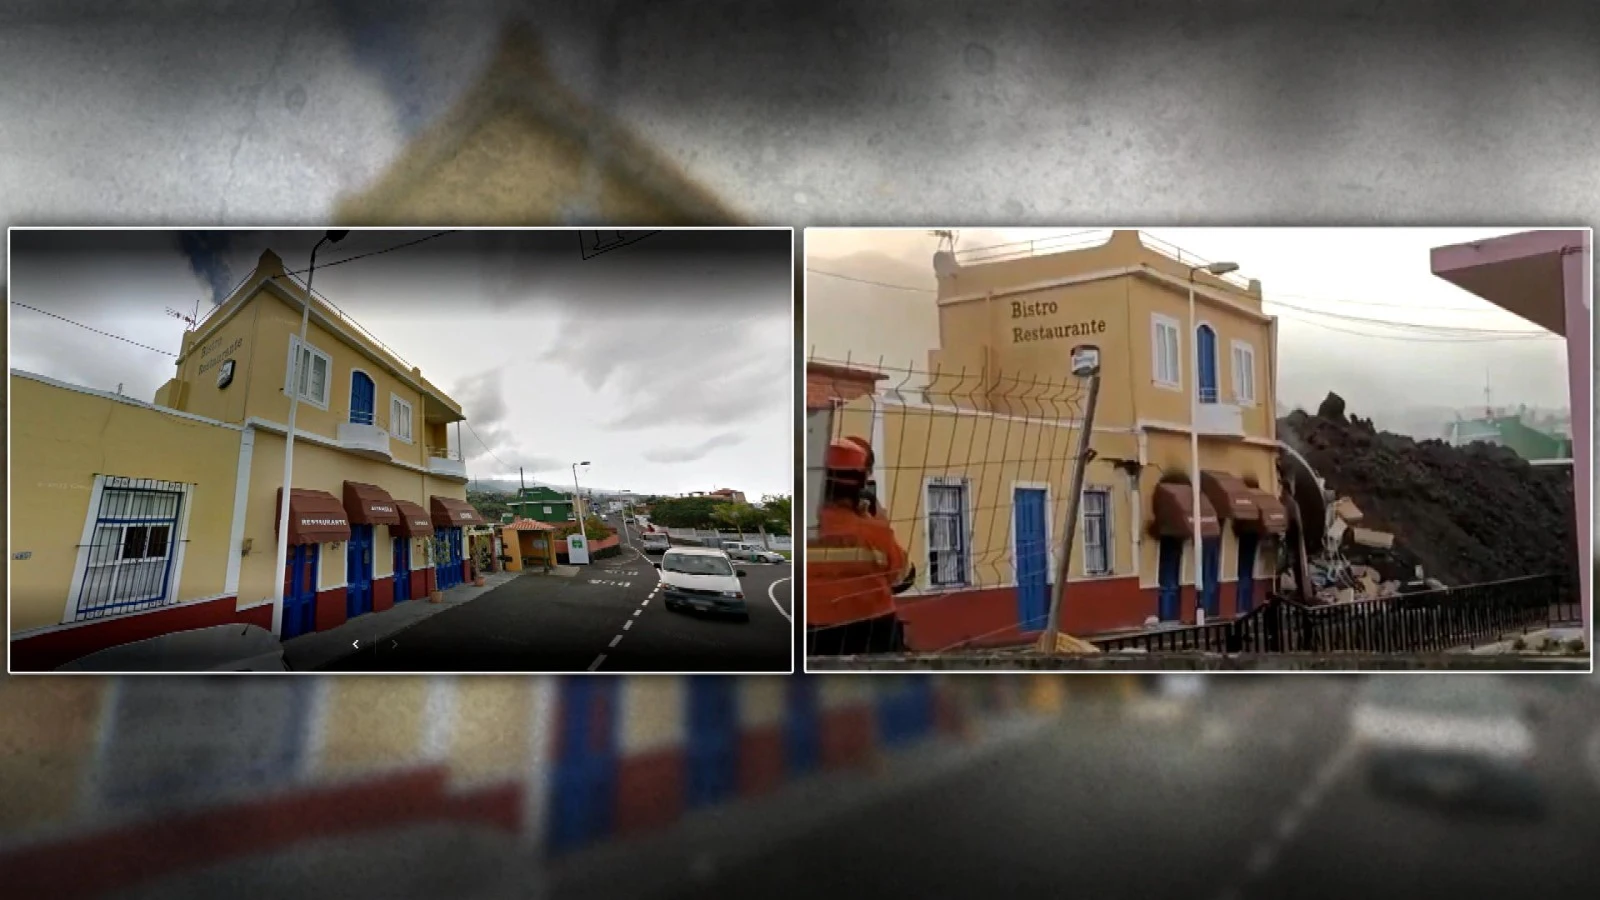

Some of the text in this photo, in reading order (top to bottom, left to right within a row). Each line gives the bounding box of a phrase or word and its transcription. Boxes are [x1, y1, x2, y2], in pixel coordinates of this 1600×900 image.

[1011, 300, 1058, 319] Bistro
[1013, 319, 1106, 343] Restaurante
[301, 518, 347, 526] RESTAURANTE
